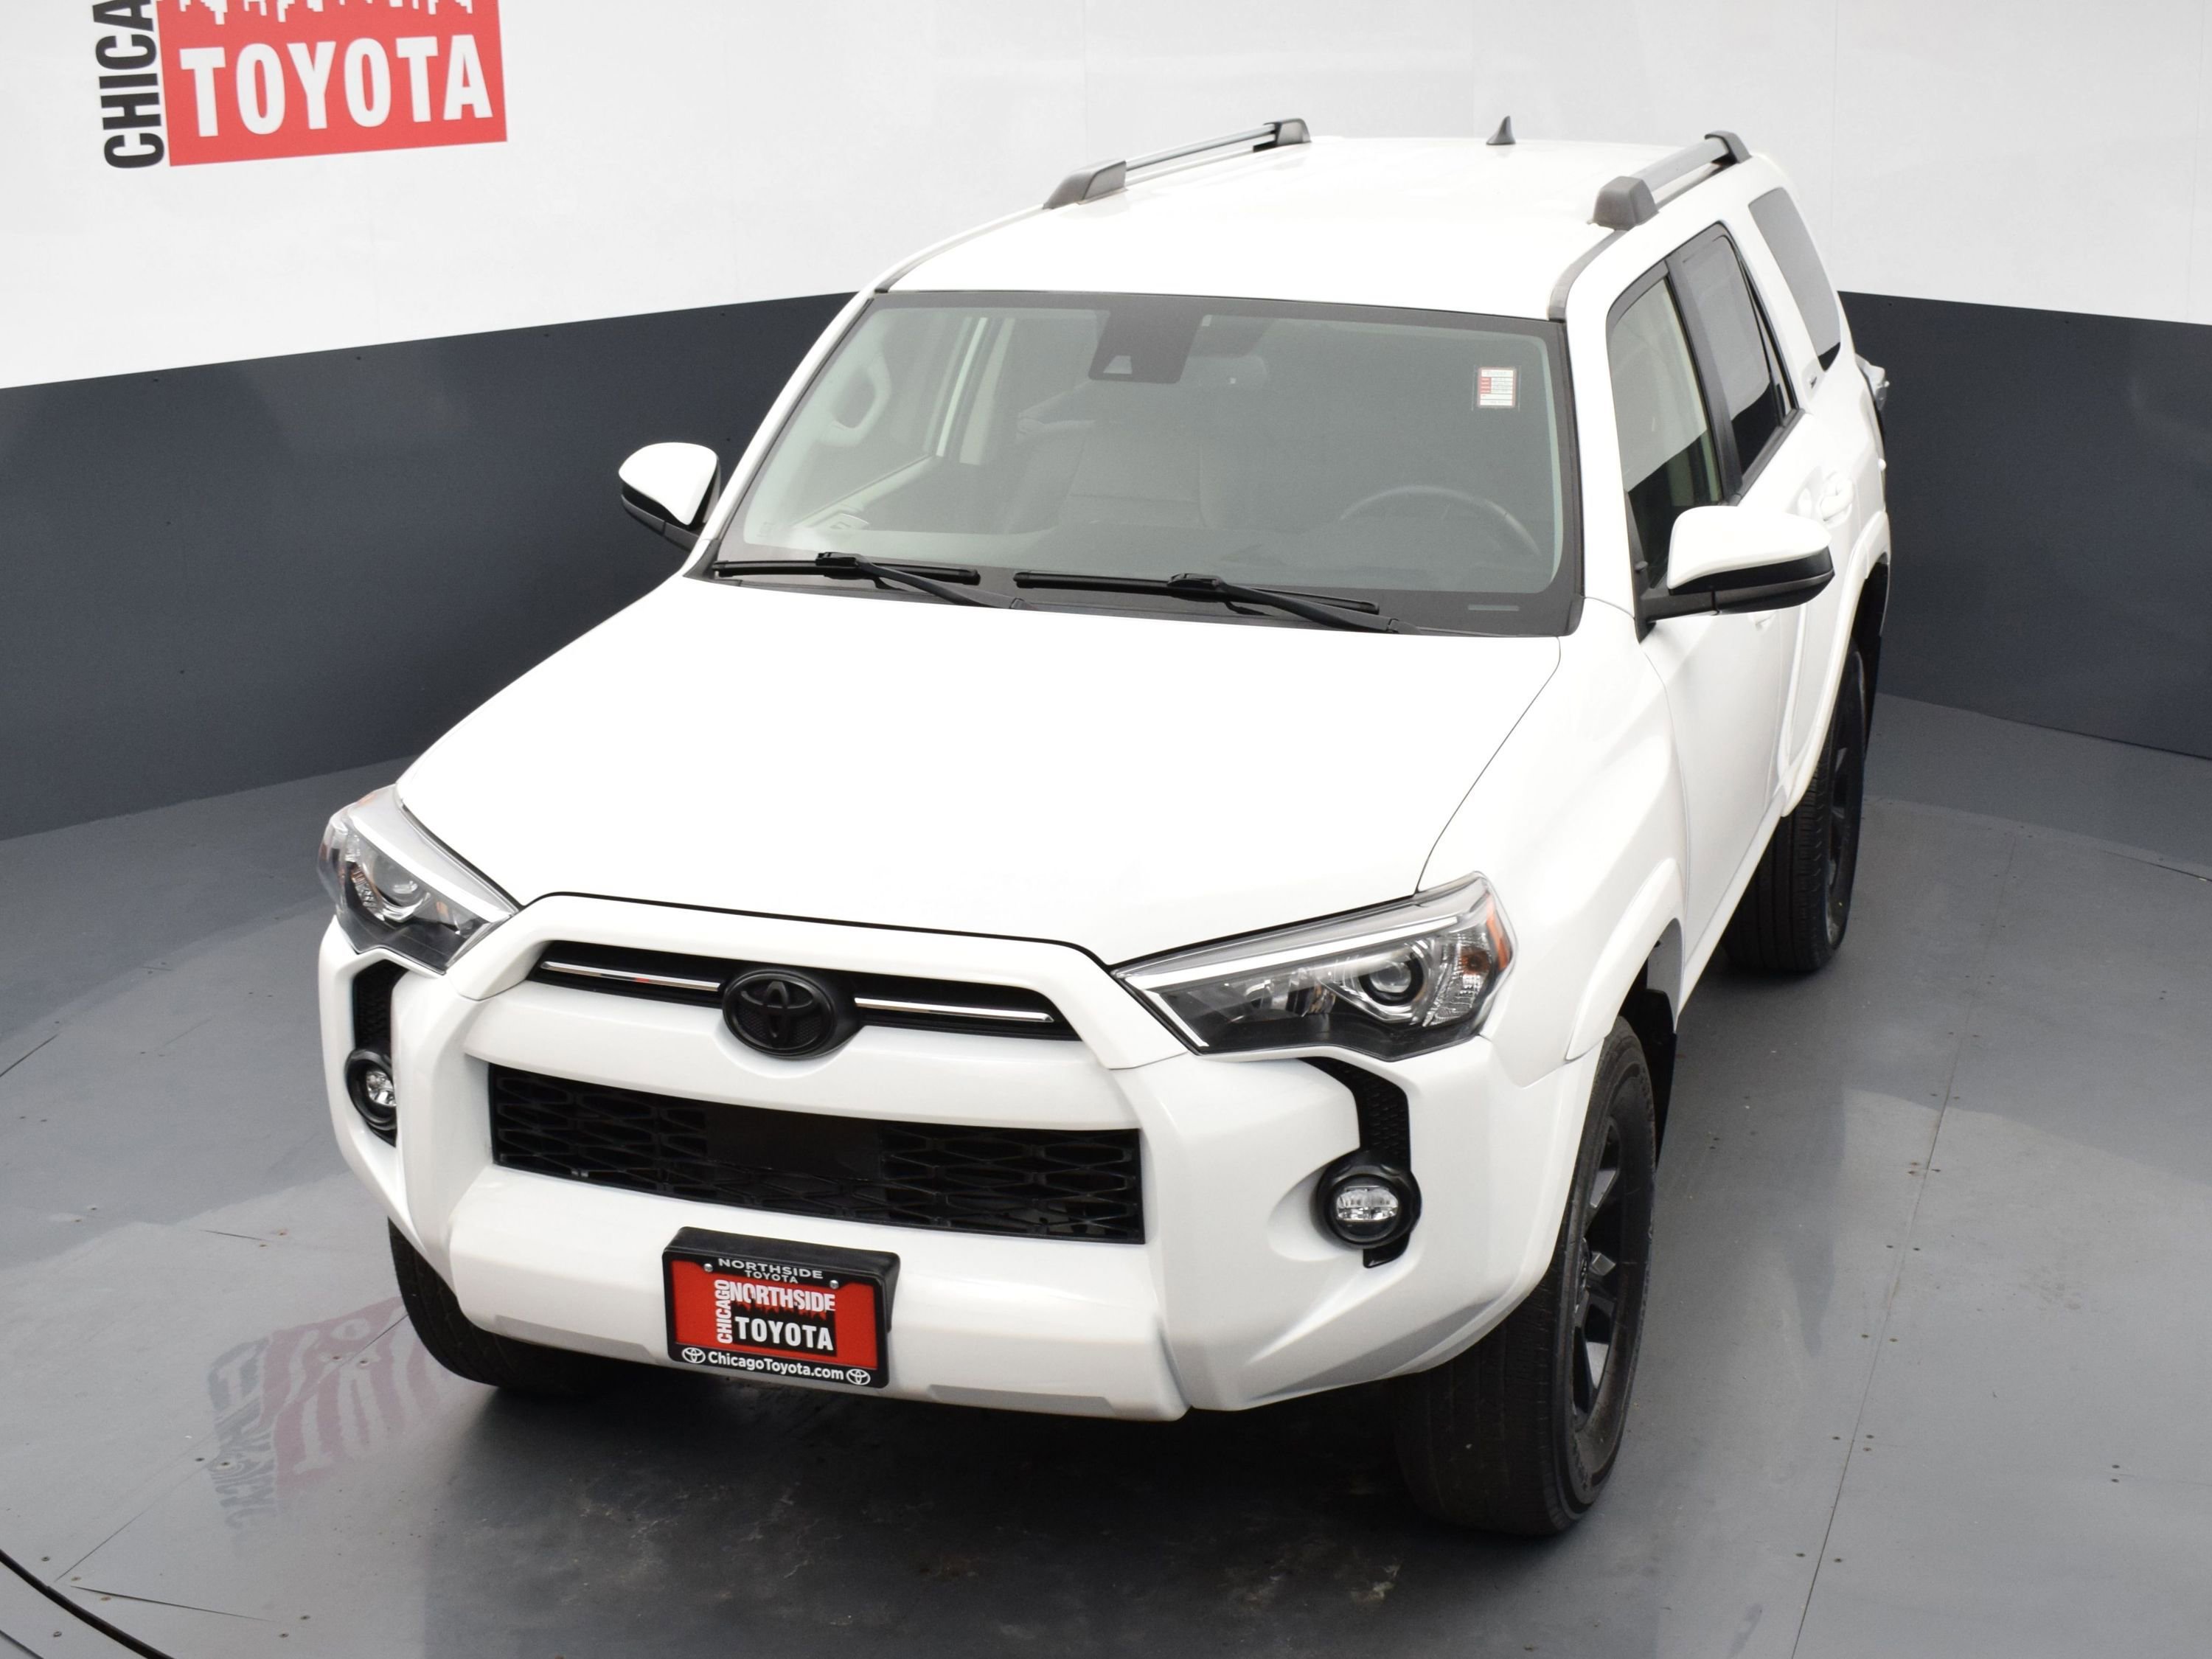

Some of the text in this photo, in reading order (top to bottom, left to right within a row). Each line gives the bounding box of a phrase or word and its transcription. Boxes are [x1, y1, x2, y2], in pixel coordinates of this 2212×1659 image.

[179, 34, 493, 137] TOYOTA
[718, 1258, 823, 1279] NORTHSIDE
[746, 1270, 799, 1284] TOYOTA
[730, 1281, 835, 1311] NORTHSIDE
[714, 1280, 732, 1343] CHICAGO
[735, 1317, 833, 1351] TOYOTA
[709, 1352, 844, 1380] ChicagoToyota.com
